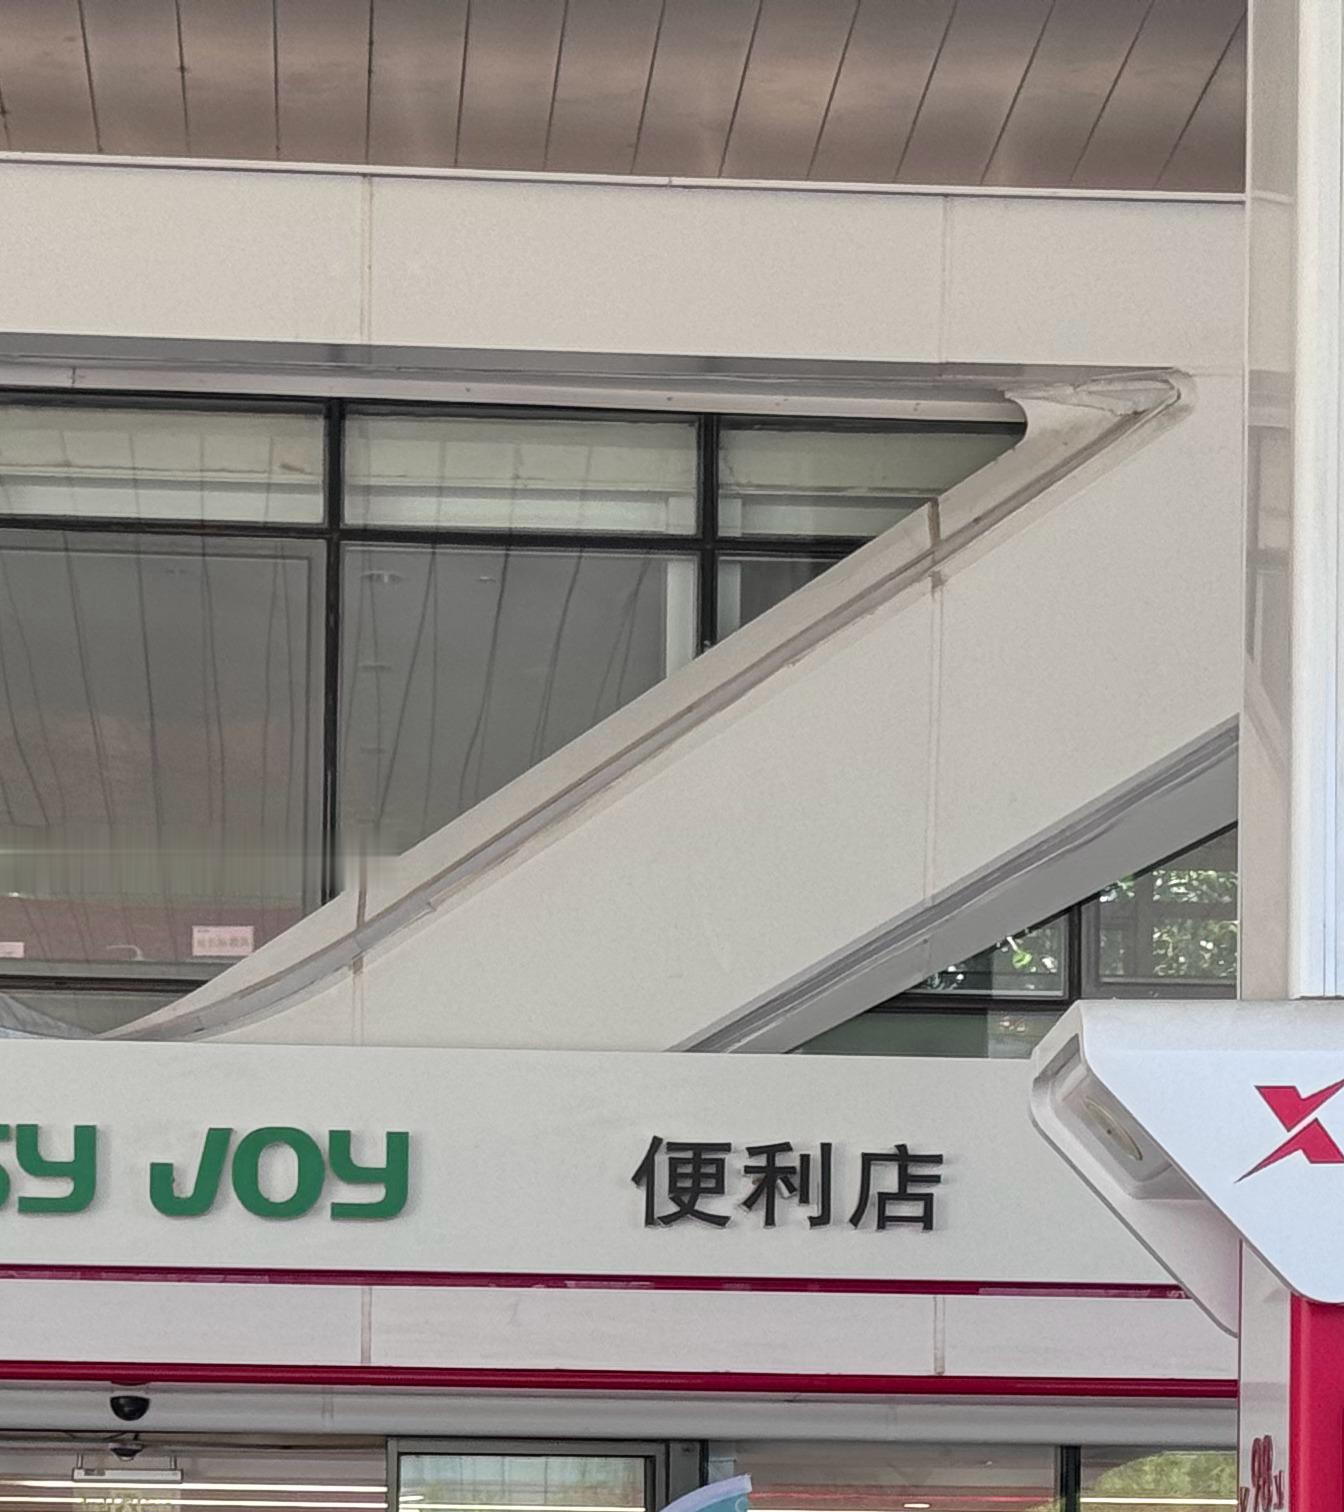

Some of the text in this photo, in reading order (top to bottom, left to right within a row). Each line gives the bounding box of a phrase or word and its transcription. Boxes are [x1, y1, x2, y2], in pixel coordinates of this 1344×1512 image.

[149, 1126, 410, 1221] JOY
[632, 1135, 944, 1231] 便利店
